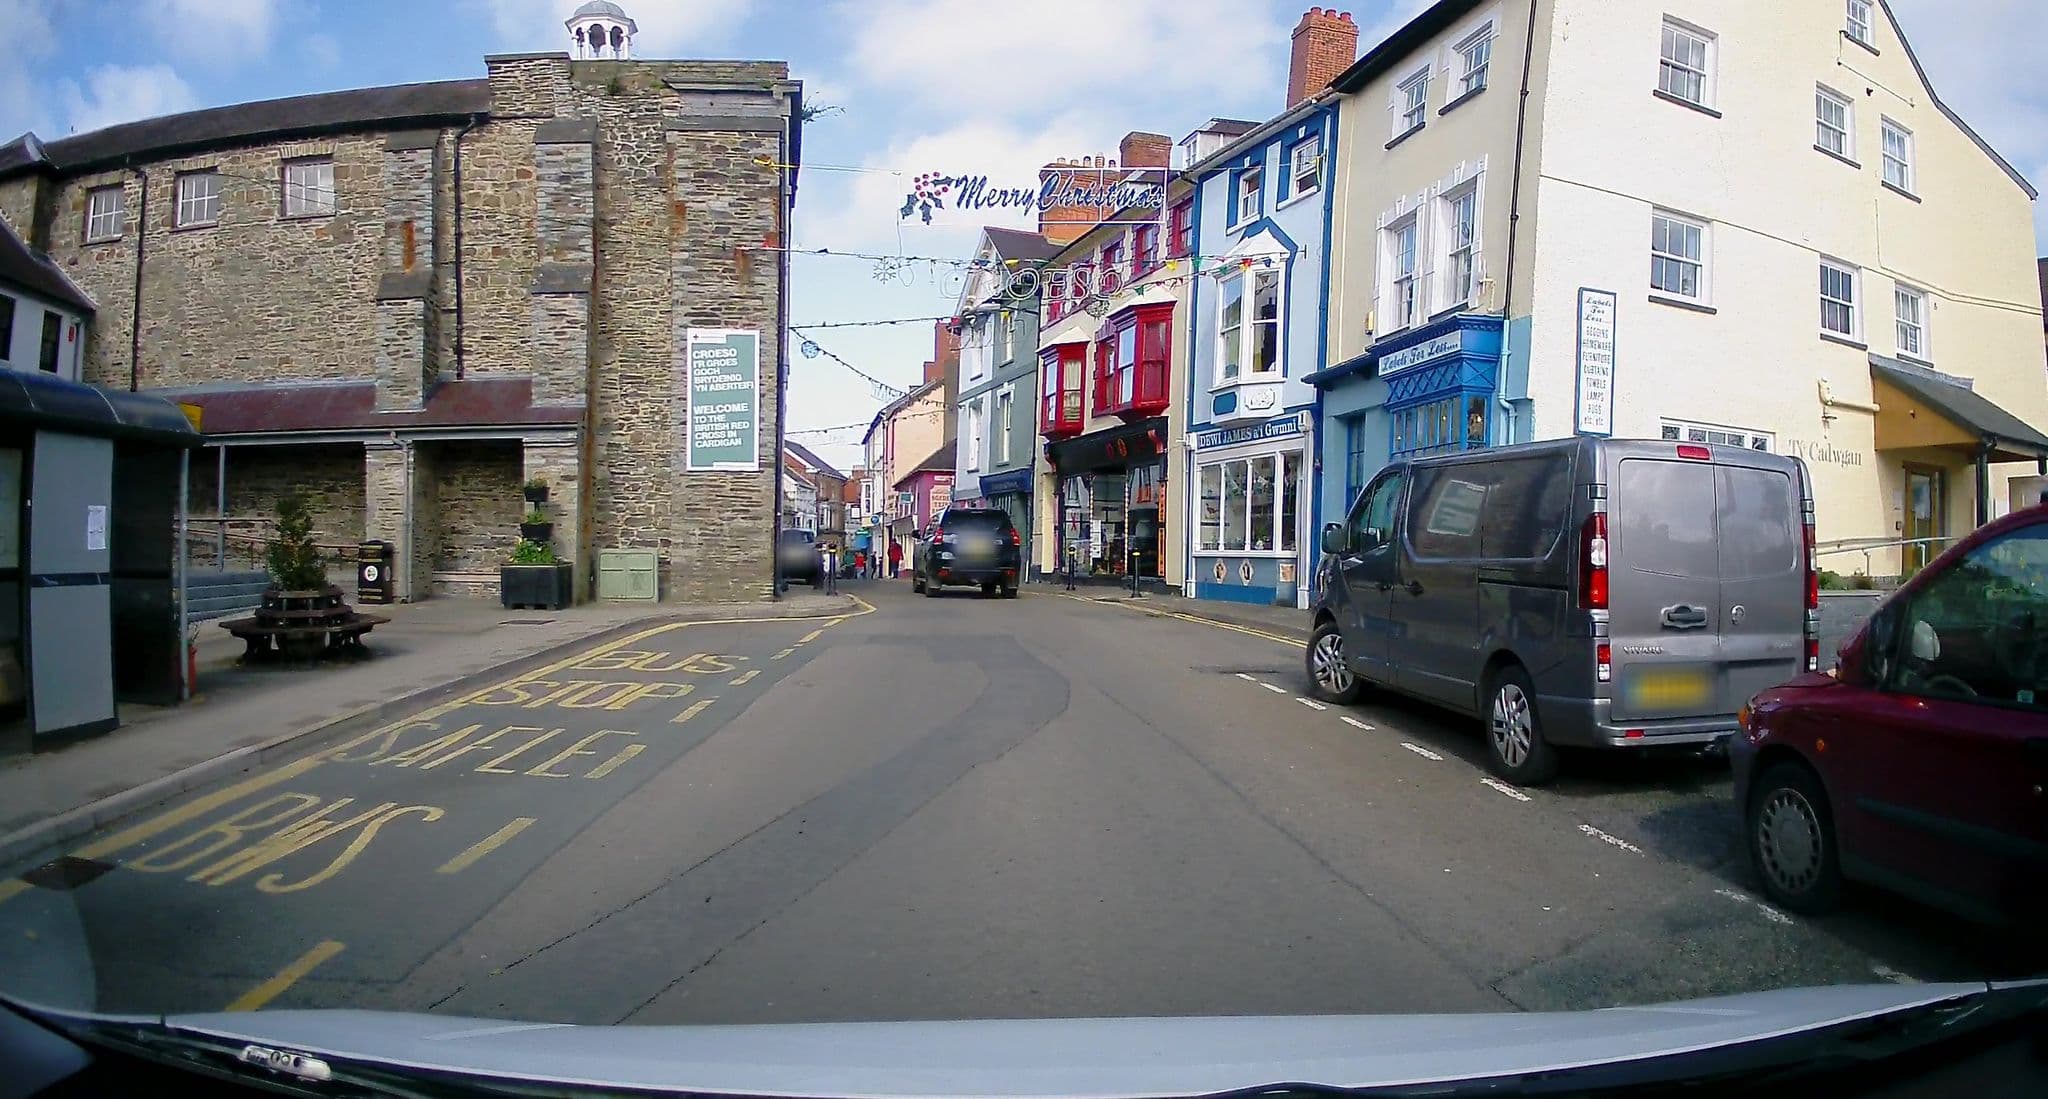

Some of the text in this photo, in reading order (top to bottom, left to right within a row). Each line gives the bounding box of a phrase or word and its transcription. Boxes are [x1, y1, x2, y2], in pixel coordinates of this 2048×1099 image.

[955, 169, 1164, 216] Merry Christmas
[693, 348, 737, 359] CROESO
[1409, 347, 1425, 363] For
[706, 358, 738, 368] GROES
[694, 367, 720, 376] GOCH
[695, 384, 708, 392] YN
[1586, 389, 1604, 402] LAMPS
[694, 403, 749, 415] WELCOME
[694, 414, 726, 424] TO THE
[695, 421, 750, 432] BRITISH RED
[1200, 432, 1221, 448] DEWI
[1222, 427, 1252, 444] JAMES
[1265, 417, 1297, 437] Gwmni
[695, 429, 737, 440] CROSS IN
[695, 438, 742, 448] CARDIGAN
[1809, 441, 1862, 468] Cadwgan
[568, 651, 749, 674] BUS
[470, 681, 696, 710] STOP
[332, 722, 640, 778] SAFLE
[125, 792, 445, 893] BWS
